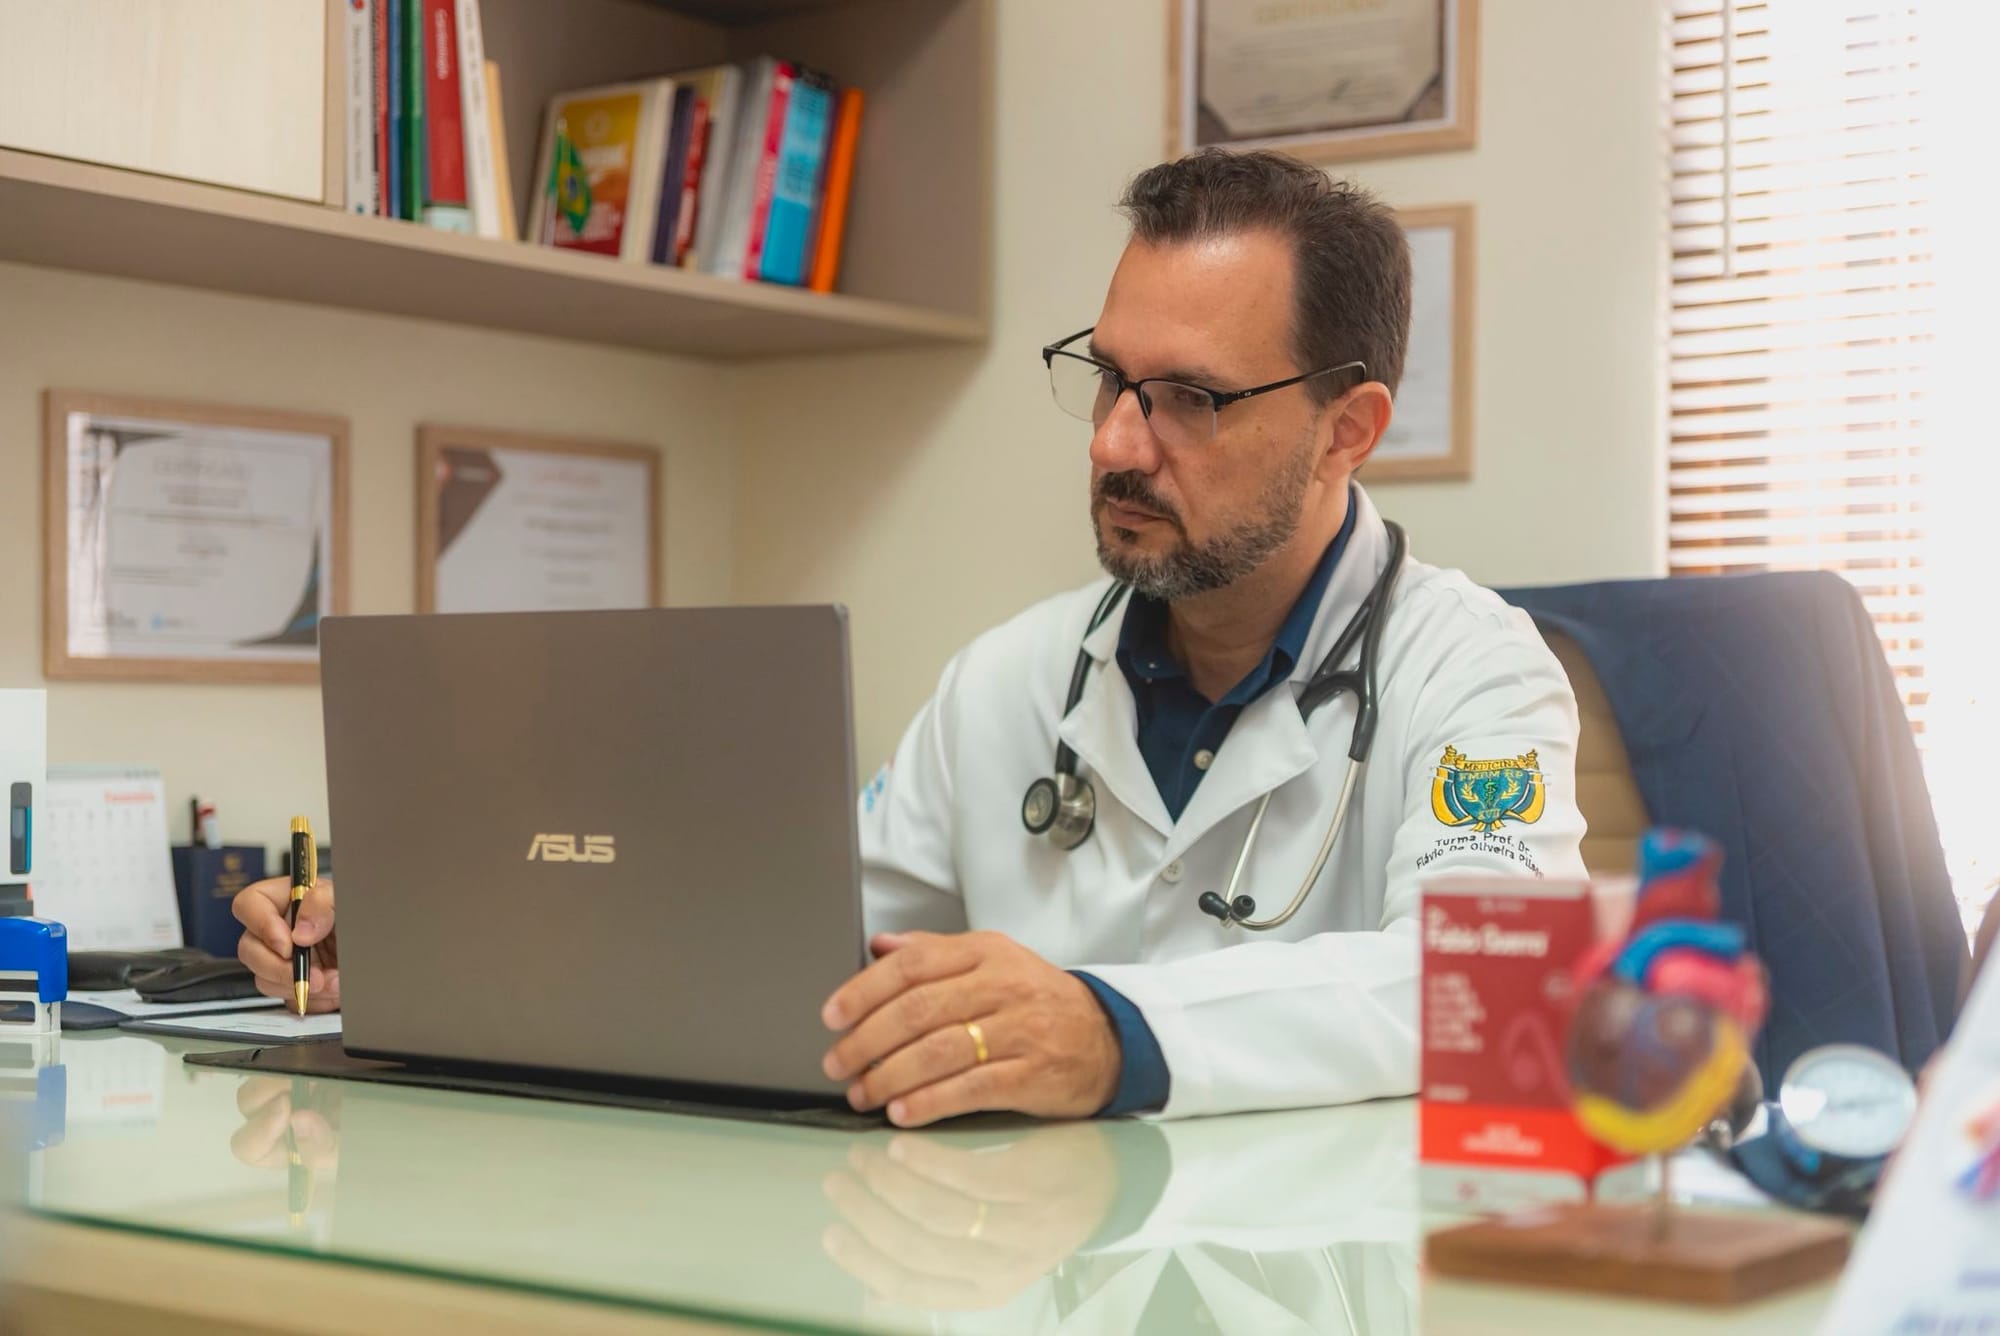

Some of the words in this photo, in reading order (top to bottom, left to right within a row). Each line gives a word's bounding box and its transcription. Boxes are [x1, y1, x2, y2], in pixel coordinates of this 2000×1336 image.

[1463, 760, 1521, 771] MEDICINA
[526, 833, 616, 864] ASUS
[1416, 848, 1444, 870] Flávio
[1470, 842, 1515, 859] Oliveira
[1434, 835, 1477, 846] Turma
[1483, 832, 1514, 847] Prof.
[1518, 840, 1533, 858] Dr.
